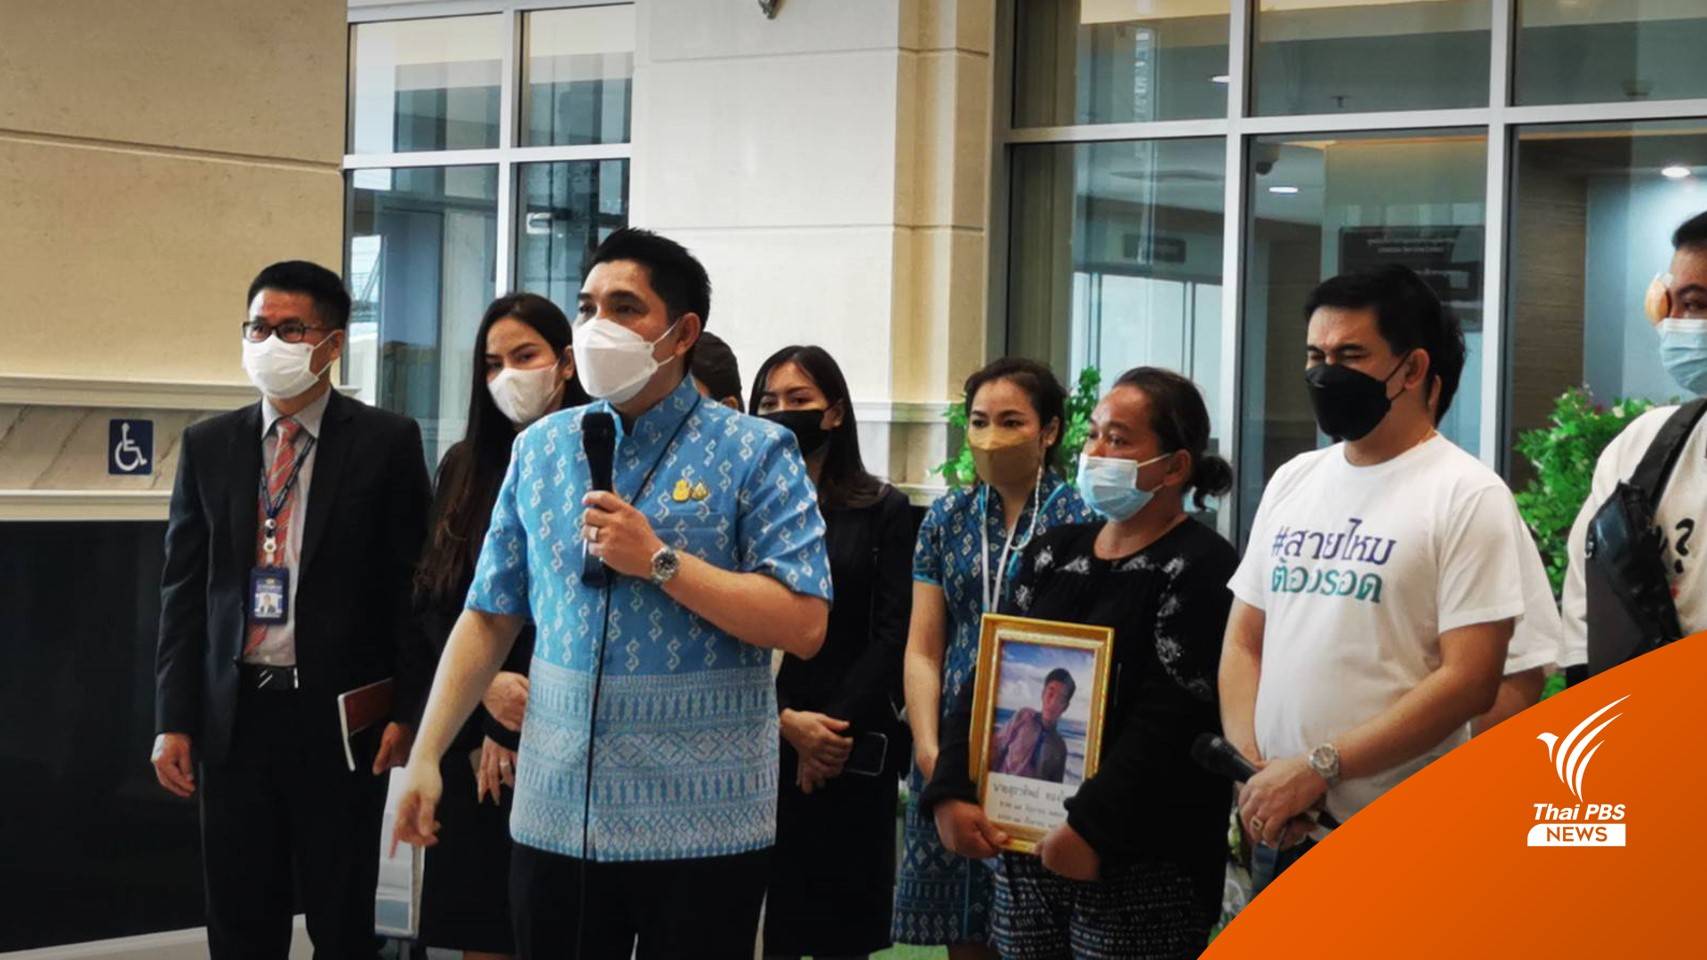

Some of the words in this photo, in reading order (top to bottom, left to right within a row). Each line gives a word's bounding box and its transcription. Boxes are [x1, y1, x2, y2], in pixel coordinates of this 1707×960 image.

[1272, 517, 1397, 565] #สายไหม
[1271, 557, 1383, 604] ต้องรอด
